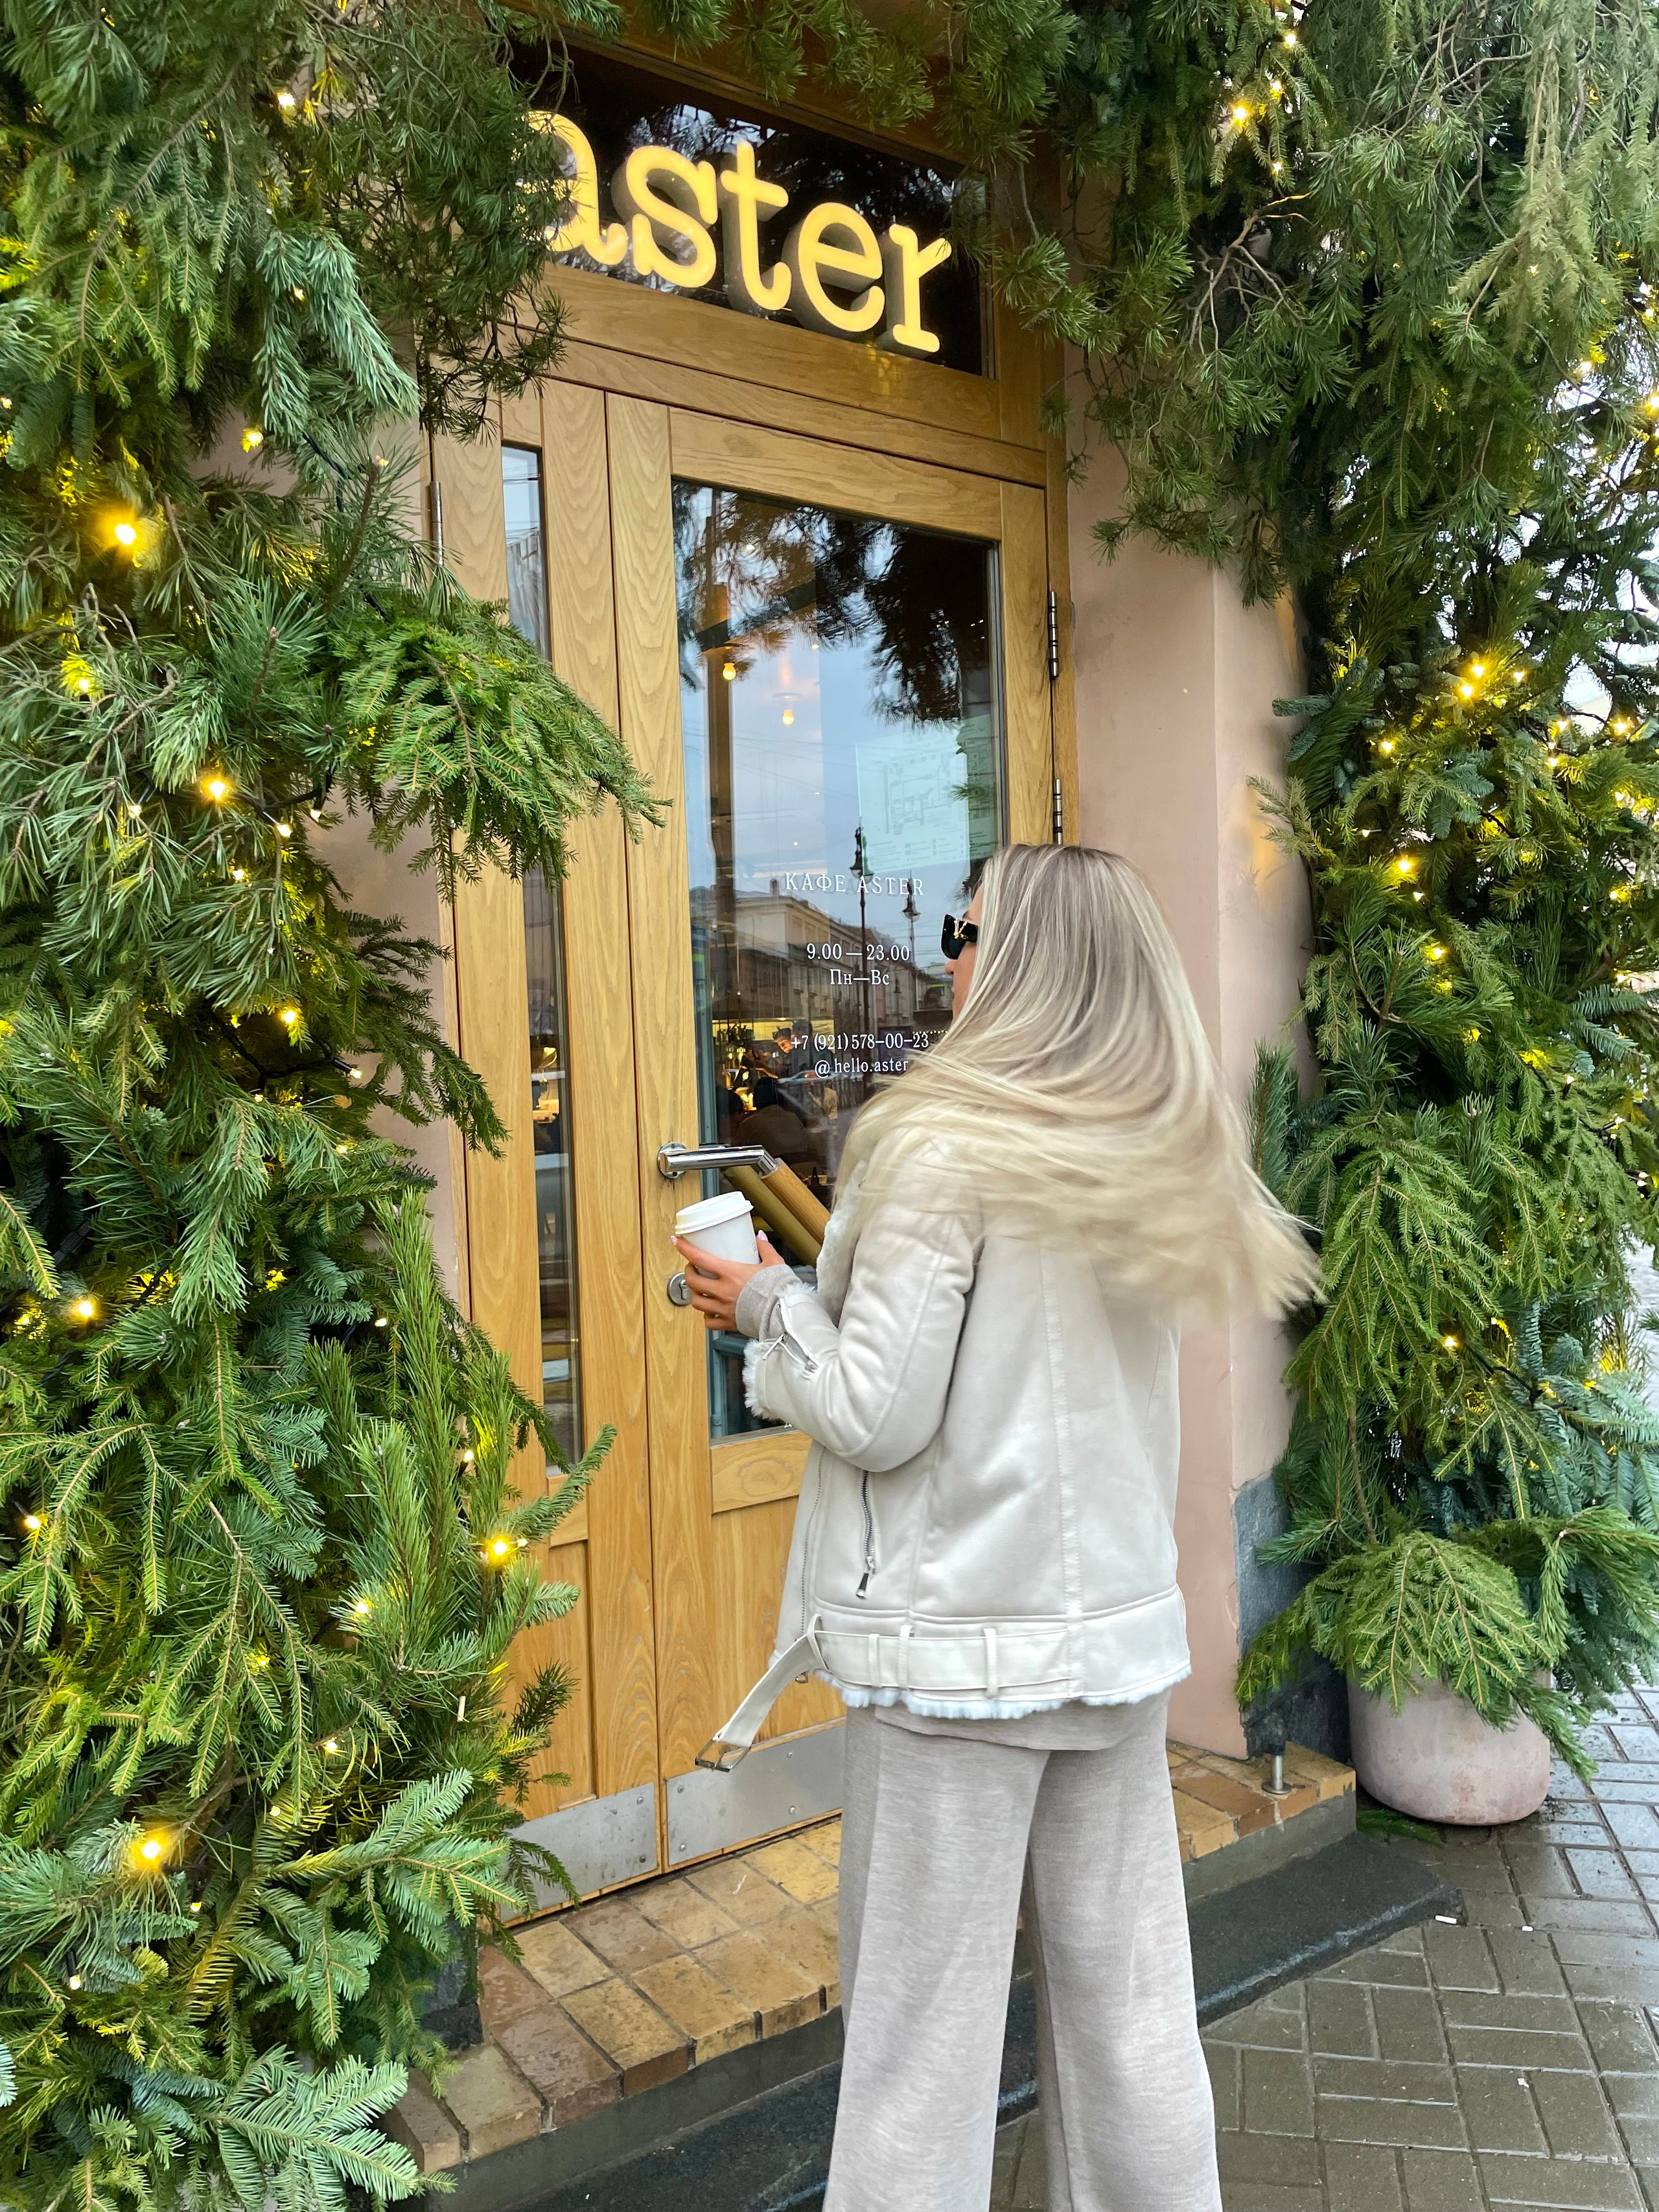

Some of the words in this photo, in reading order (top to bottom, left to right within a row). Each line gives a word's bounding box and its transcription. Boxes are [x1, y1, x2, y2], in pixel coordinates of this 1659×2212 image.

[510, 110, 953, 353] aster
[785, 872, 846, 892] КАФЕ
[857, 875, 924, 896] ASTER
[791, 1034, 809, 1051] +7
